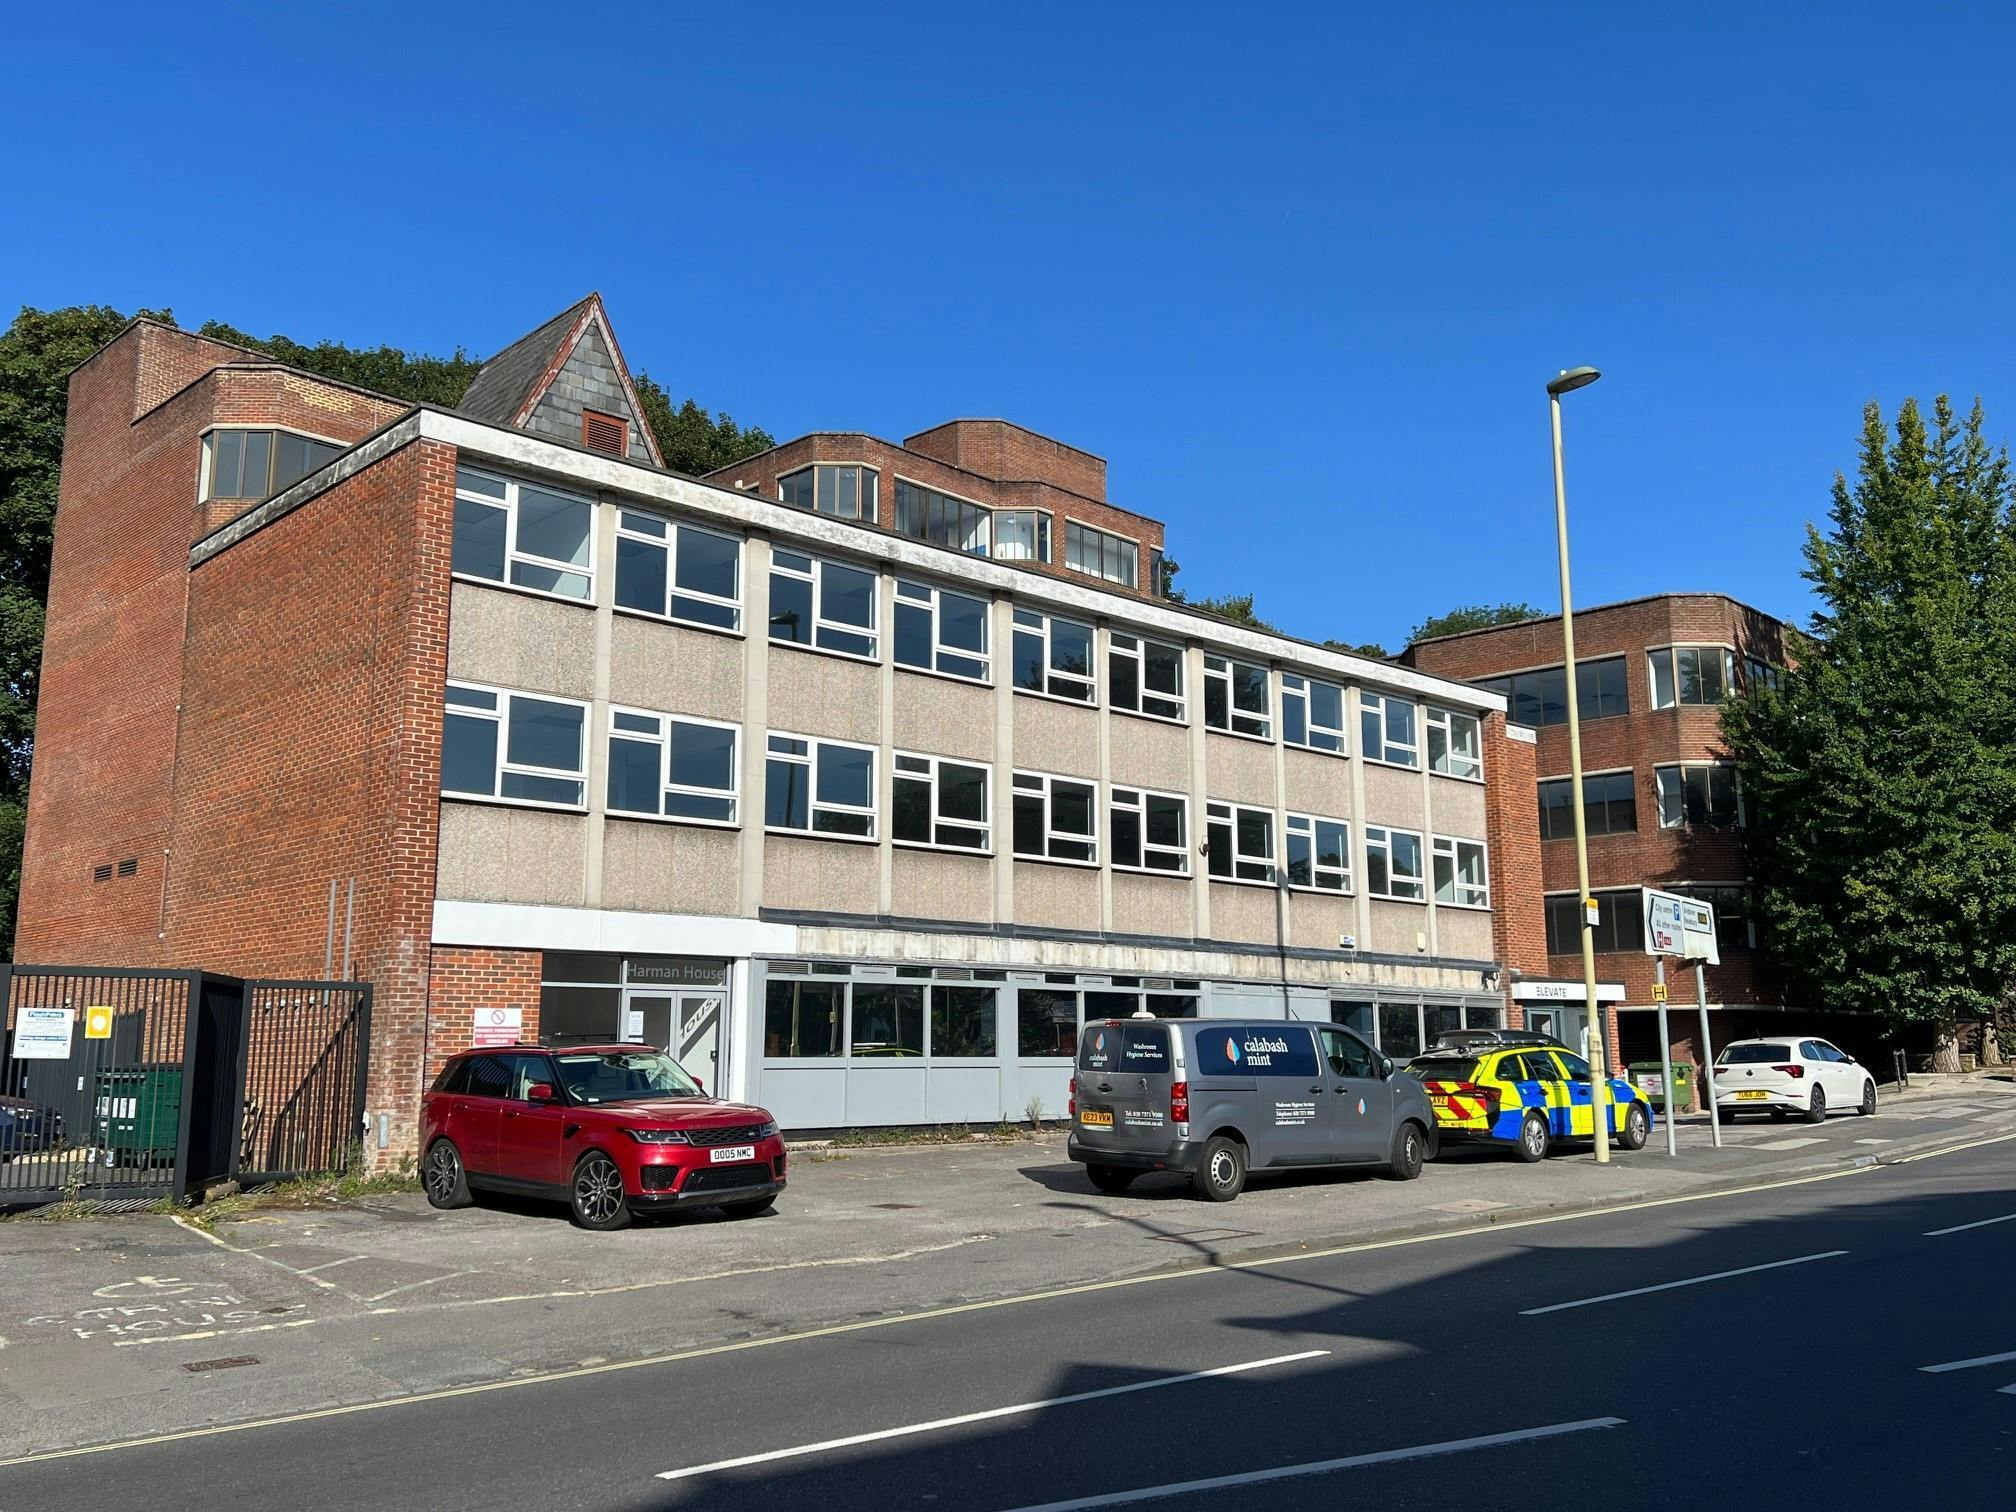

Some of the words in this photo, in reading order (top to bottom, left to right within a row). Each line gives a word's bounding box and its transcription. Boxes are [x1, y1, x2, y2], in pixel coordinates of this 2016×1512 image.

[627, 963, 680, 978] Harman
[684, 965, 724, 979] House
[1536, 986, 1567, 998] ELEVATE
[1654, 986, 1665, 999] H
[1133, 1043, 1157, 1051] Washroom
[1244, 1037, 1288, 1053] calabash
[1089, 1054, 1108, 1062] calabash
[1126, 1051, 1144, 1060] Hygiene
[1247, 1053, 1272, 1066] mint
[736, 1148, 751, 1158] NMC
